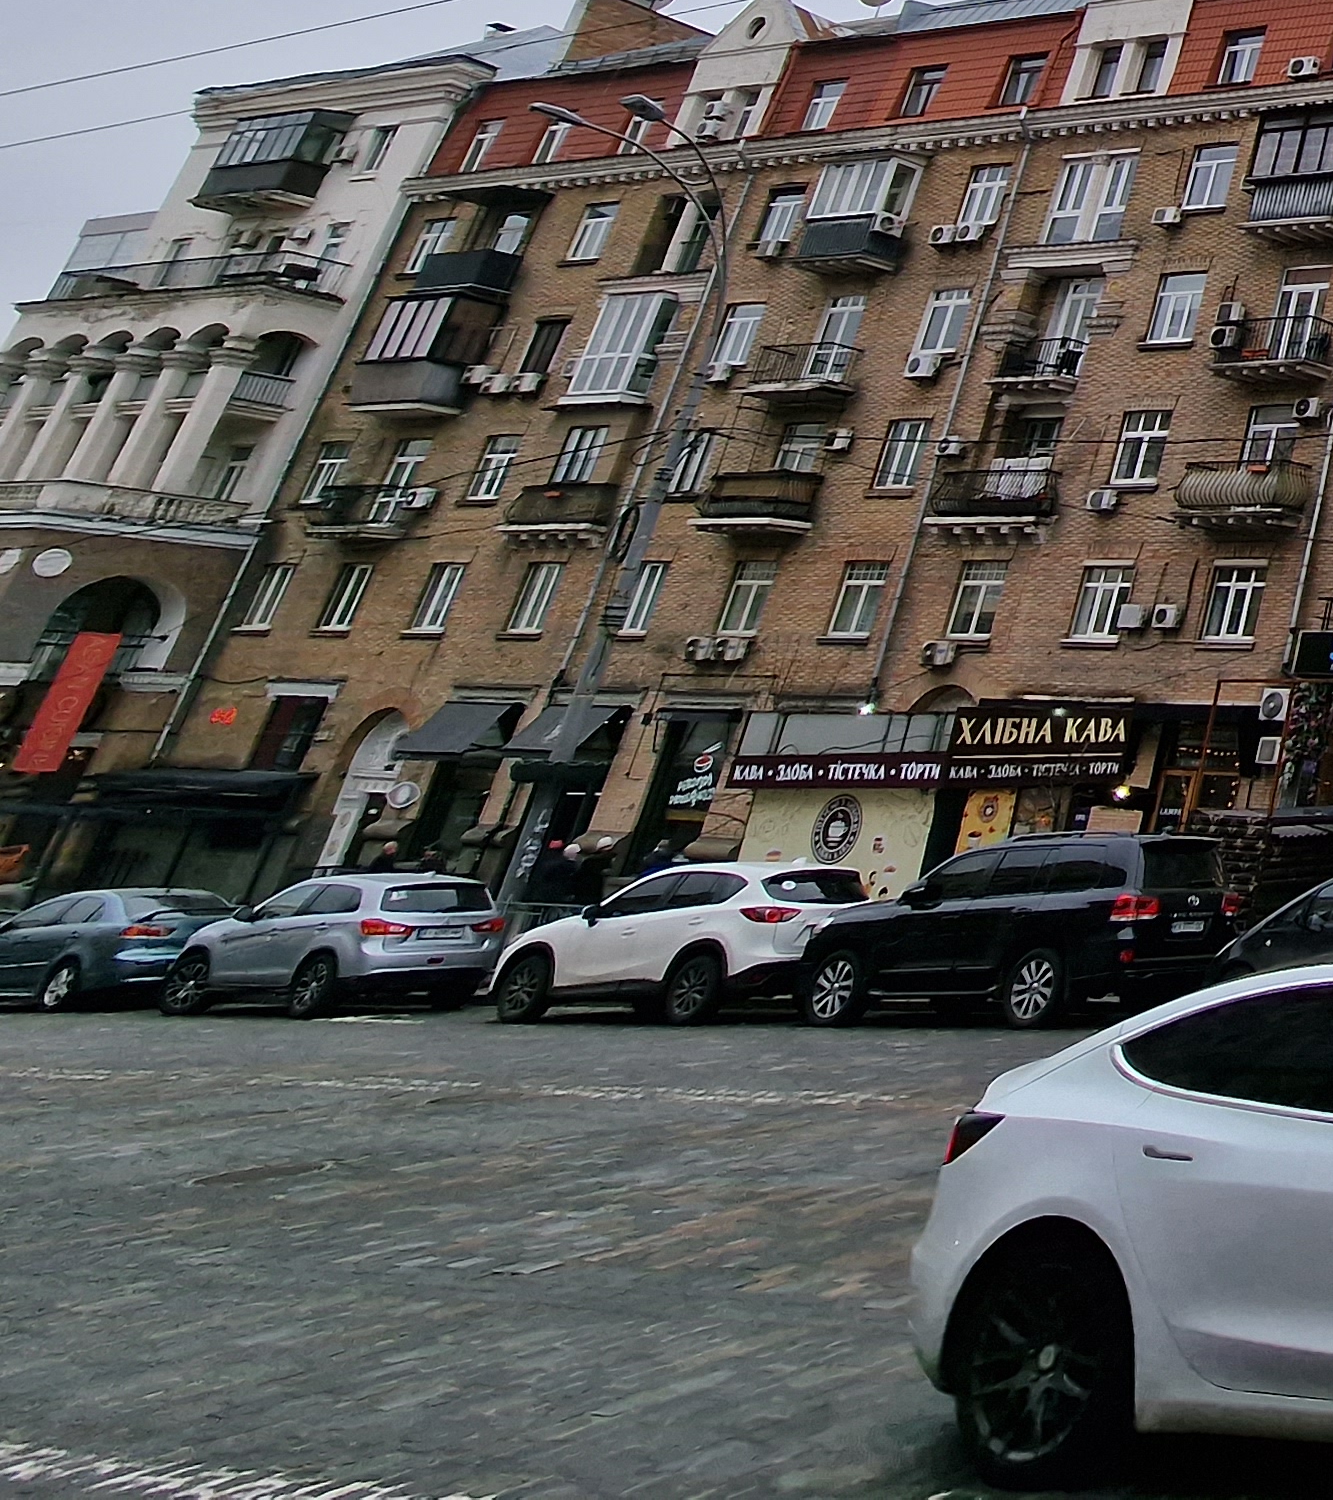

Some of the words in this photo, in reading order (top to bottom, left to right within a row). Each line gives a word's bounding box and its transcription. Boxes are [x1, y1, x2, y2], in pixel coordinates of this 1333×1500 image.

[956, 717, 1052, 745] ХЛІБНА
[1063, 717, 1126, 743] КАВА
[732, 764, 764, 781] КАВА
[775, 763, 814, 781] ЗДОБА
[827, 760, 885, 781] ТІСТЕЧКА
[900, 761, 942, 780] ТОРТИ
[949, 765, 978, 779] КАВА
[987, 764, 1022, 779] ЗДОБА
[1089, 761, 1119, 775] ТОРТИ
